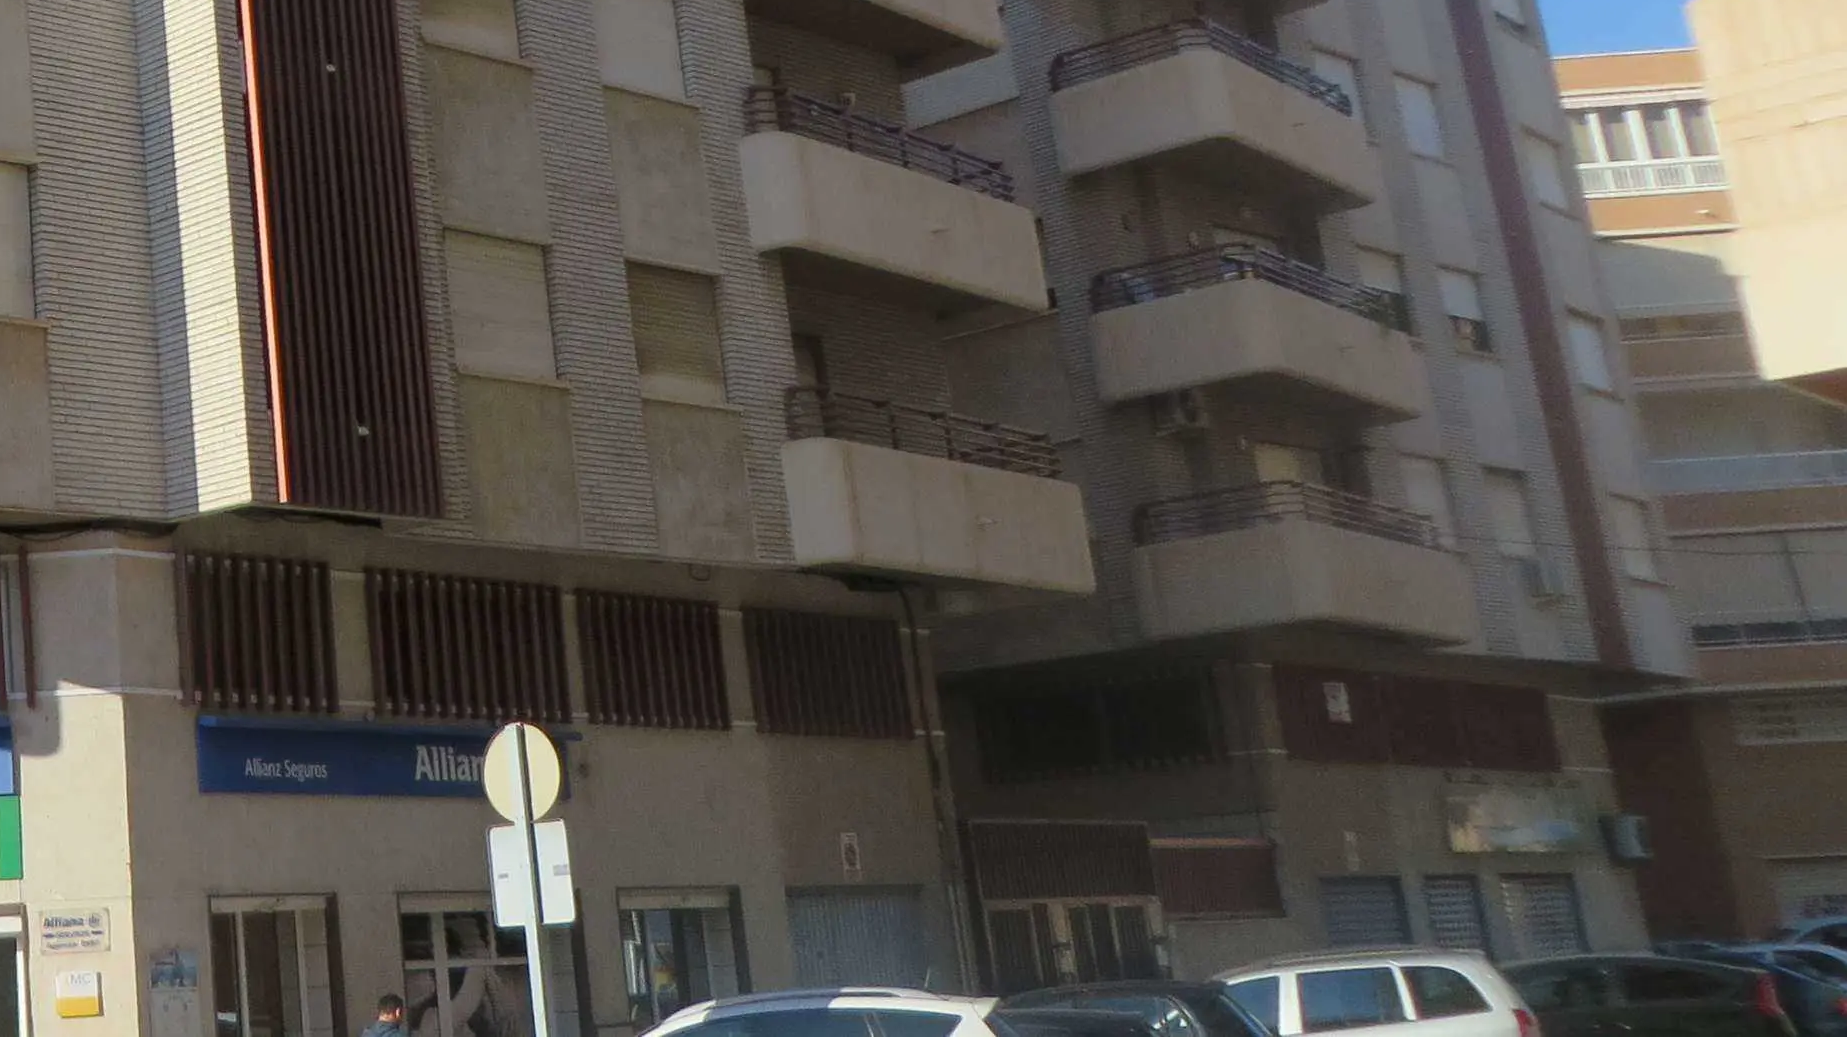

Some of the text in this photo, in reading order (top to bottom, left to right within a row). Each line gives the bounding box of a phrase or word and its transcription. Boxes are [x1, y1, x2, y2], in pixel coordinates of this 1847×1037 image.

[244, 758, 328, 782] Allianz Seguros
[415, 745, 485, 781] Allian
